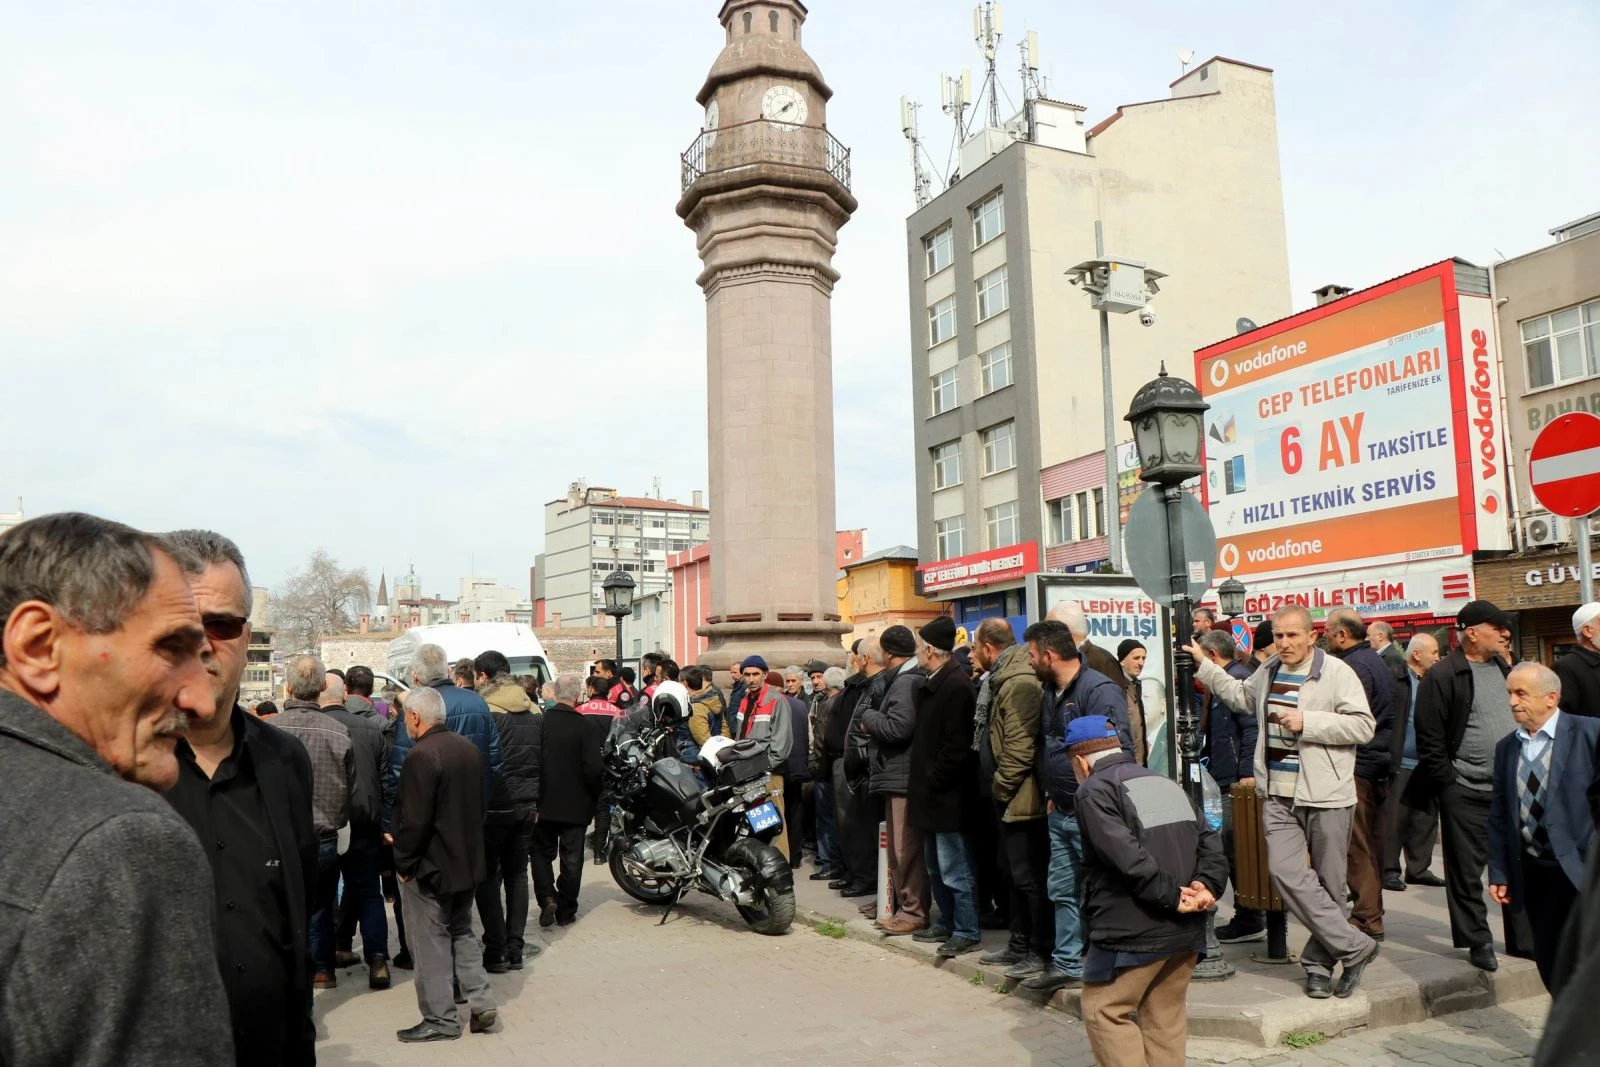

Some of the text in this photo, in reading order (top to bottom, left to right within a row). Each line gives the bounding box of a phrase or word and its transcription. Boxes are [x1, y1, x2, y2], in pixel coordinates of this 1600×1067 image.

[1233, 340, 1307, 375] vodafone
[1258, 347, 1441, 419] CEP TELEFONLARI
[1432, 374, 1442, 384] EK
[1470, 328, 1497, 480] vodafone
[1280, 412, 1447, 475] 6 AY TAKSİTLE
[1243, 468, 1436, 524] HIZLI TEKNİK SERVİS
[1247, 539, 1322, 563] vodafone
[1080, 598, 1134, 614] LEDİYE
[1245, 580, 1404, 614] GÖZEN İLETİŞİM
[1085, 615, 1132, 637] NÜL
